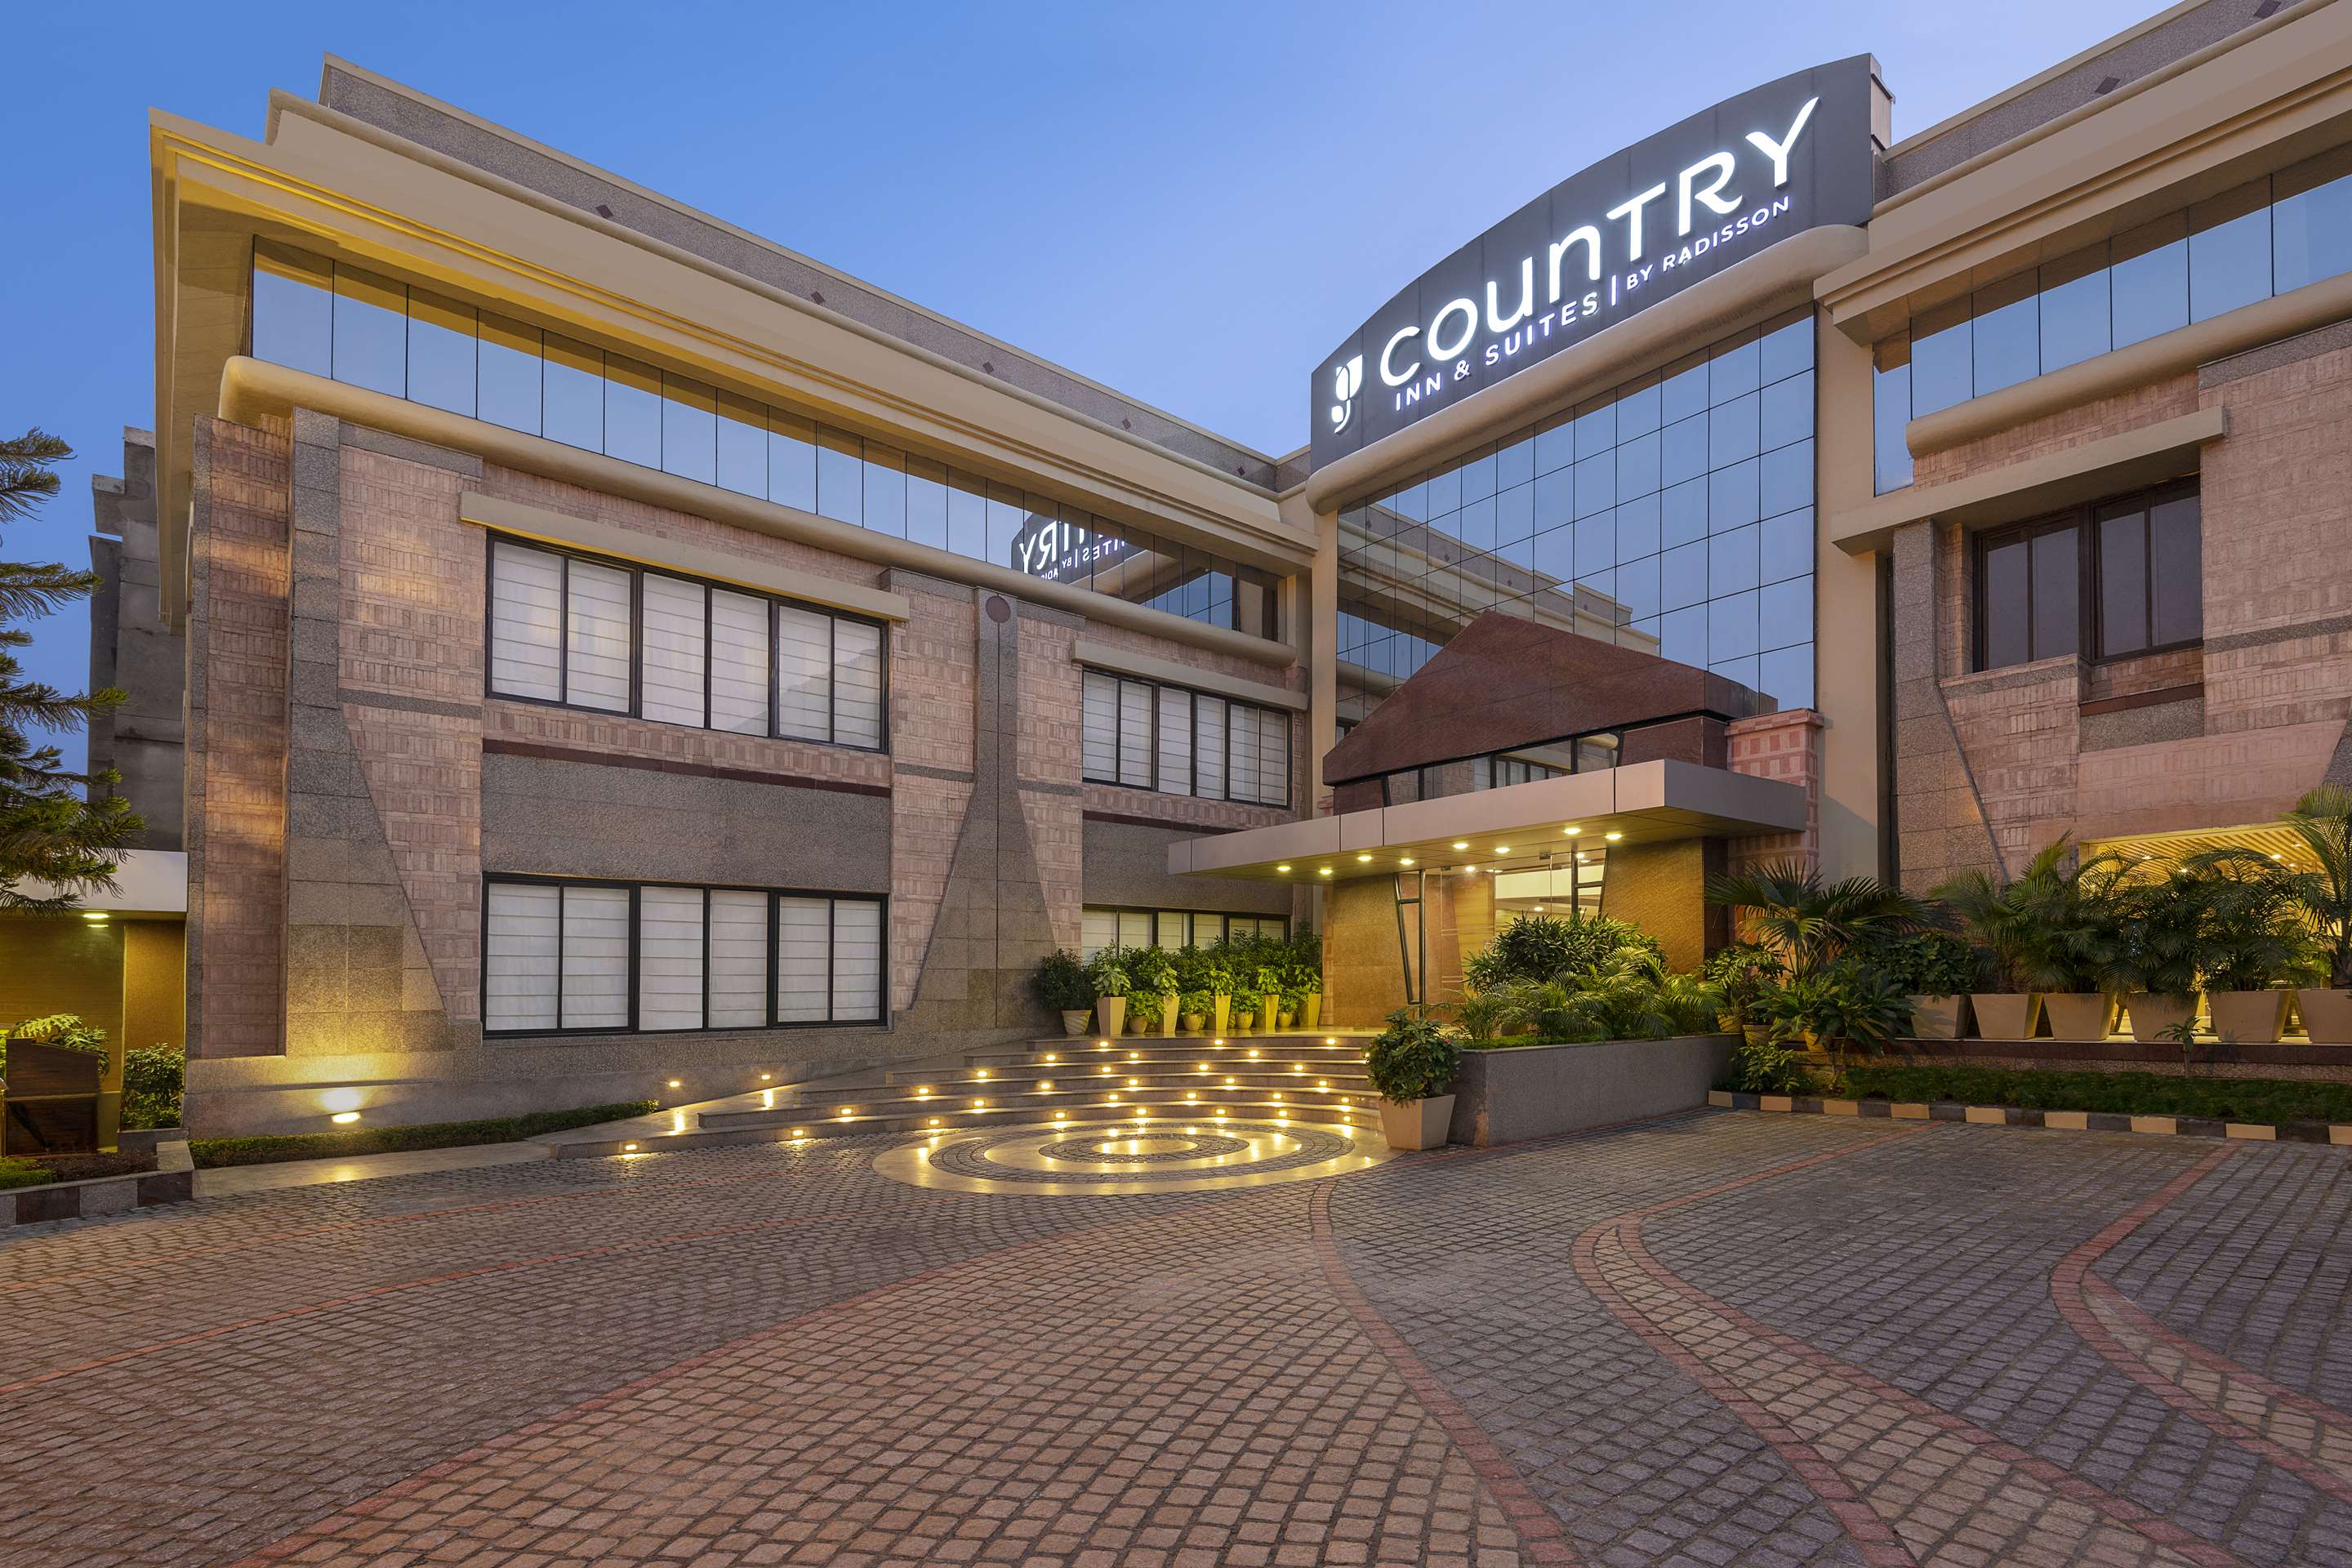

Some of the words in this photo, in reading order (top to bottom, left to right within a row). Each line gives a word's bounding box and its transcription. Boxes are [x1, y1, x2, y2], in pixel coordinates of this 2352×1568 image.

[1395, 372, 1442, 412] INN
[1454, 359, 1471, 383] &
[1485, 291, 1600, 367] SUITES
[1625, 262, 1654, 292] BY
[1663, 195, 1790, 273] RADISSON
